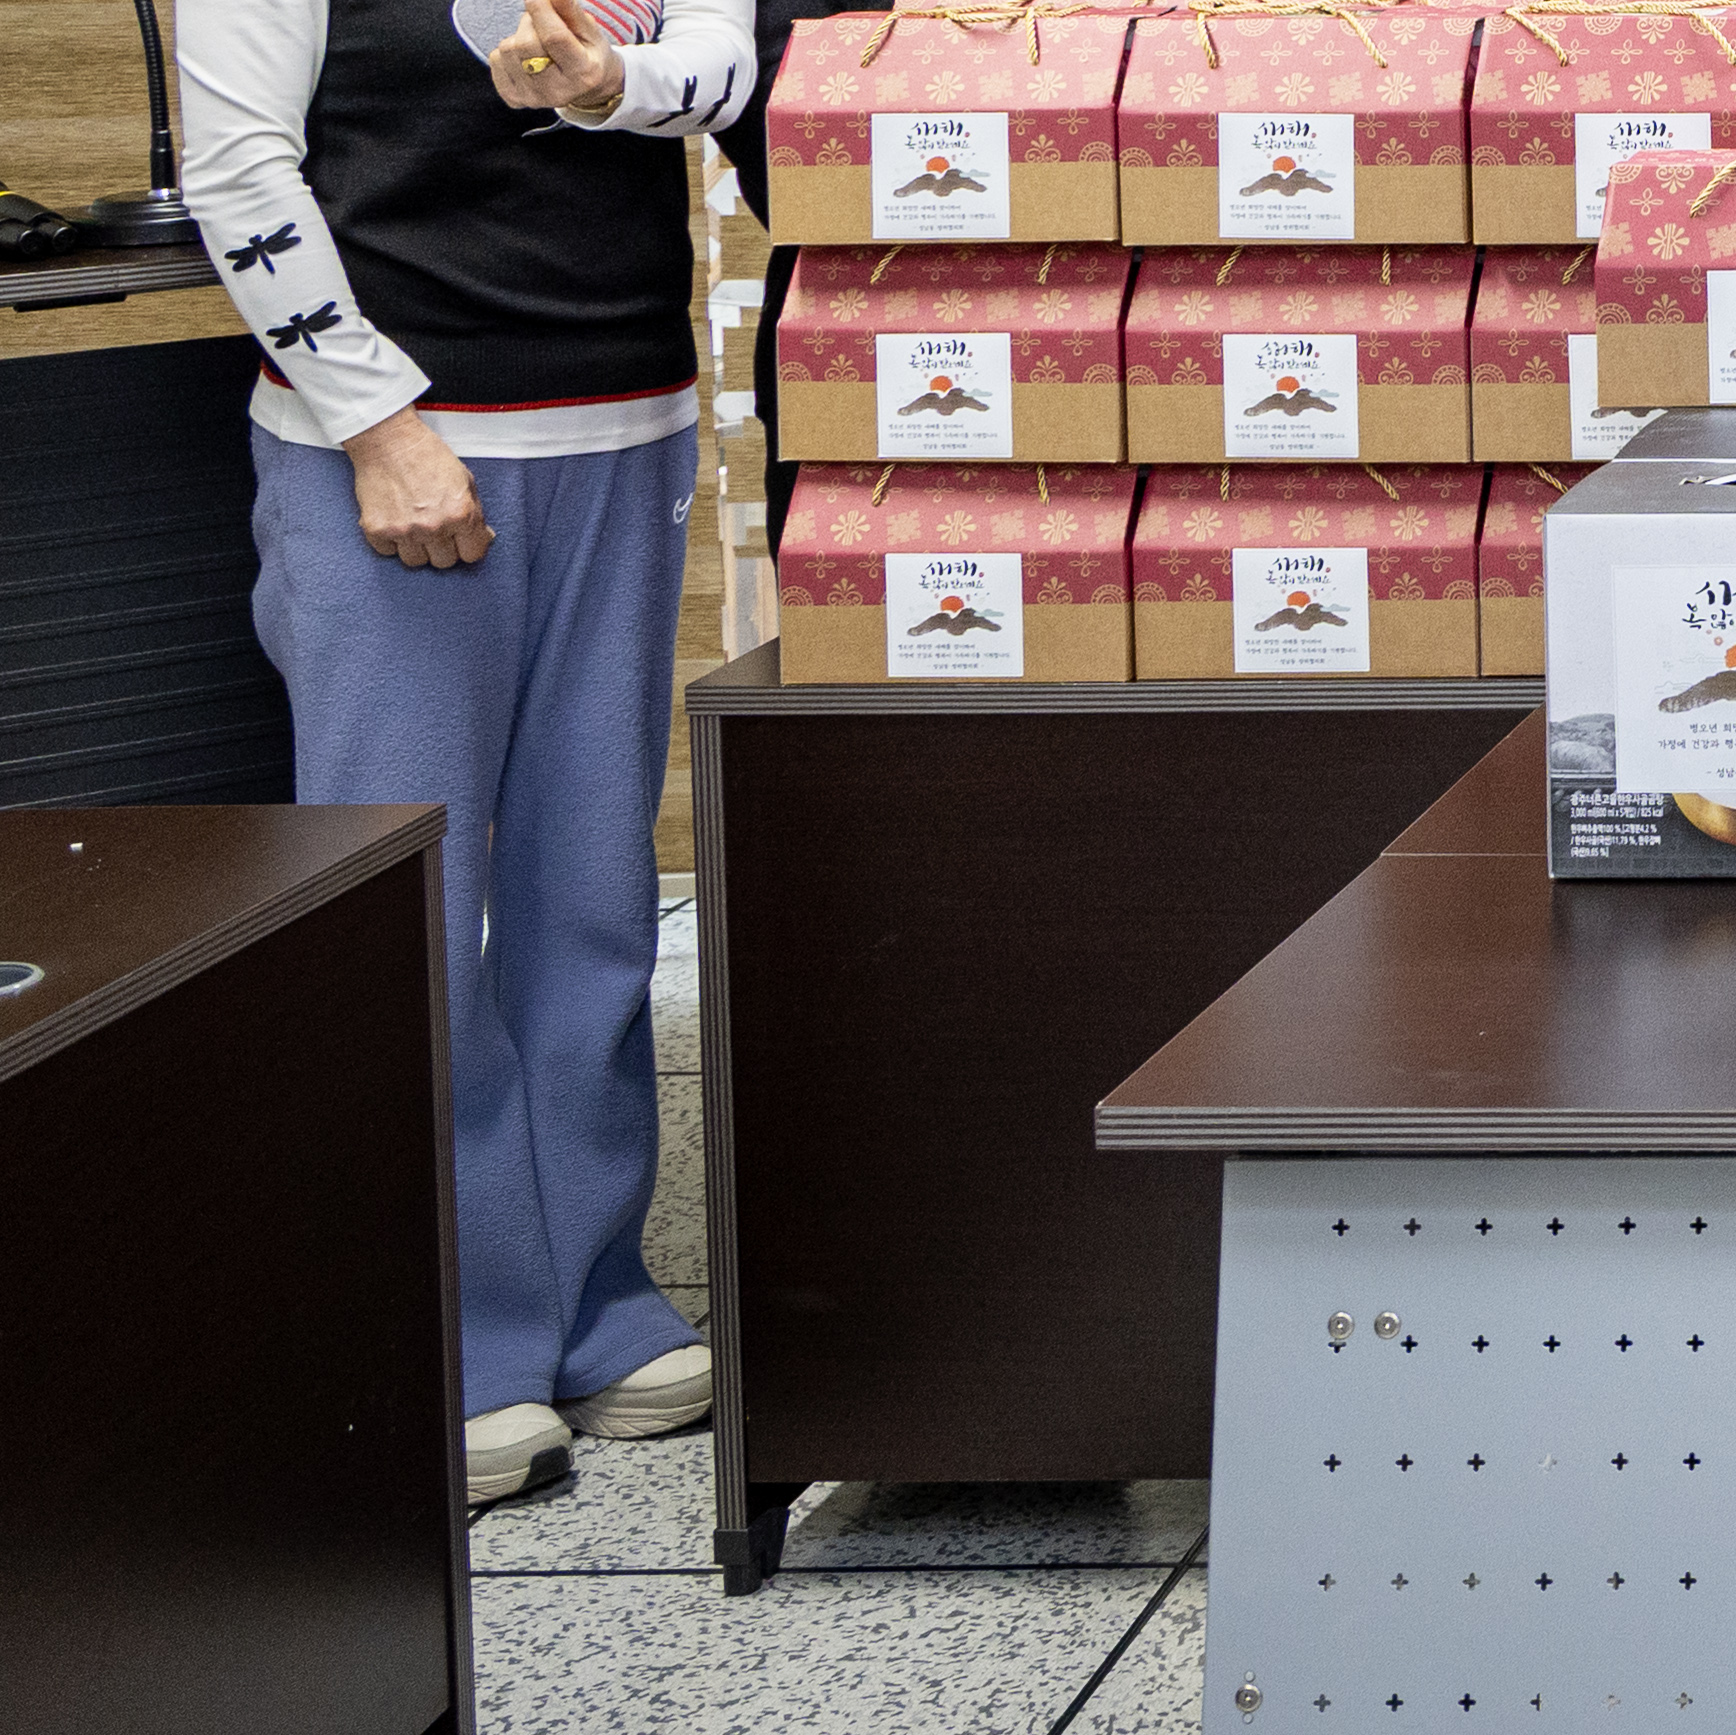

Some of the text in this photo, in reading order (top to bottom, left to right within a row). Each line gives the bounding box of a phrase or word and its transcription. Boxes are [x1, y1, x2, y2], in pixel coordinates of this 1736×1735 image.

[1690, 722, 1718, 732] 병오년
[1658, 739, 1686, 749] 가정에
[1692, 739, 1720, 749] 건강과
